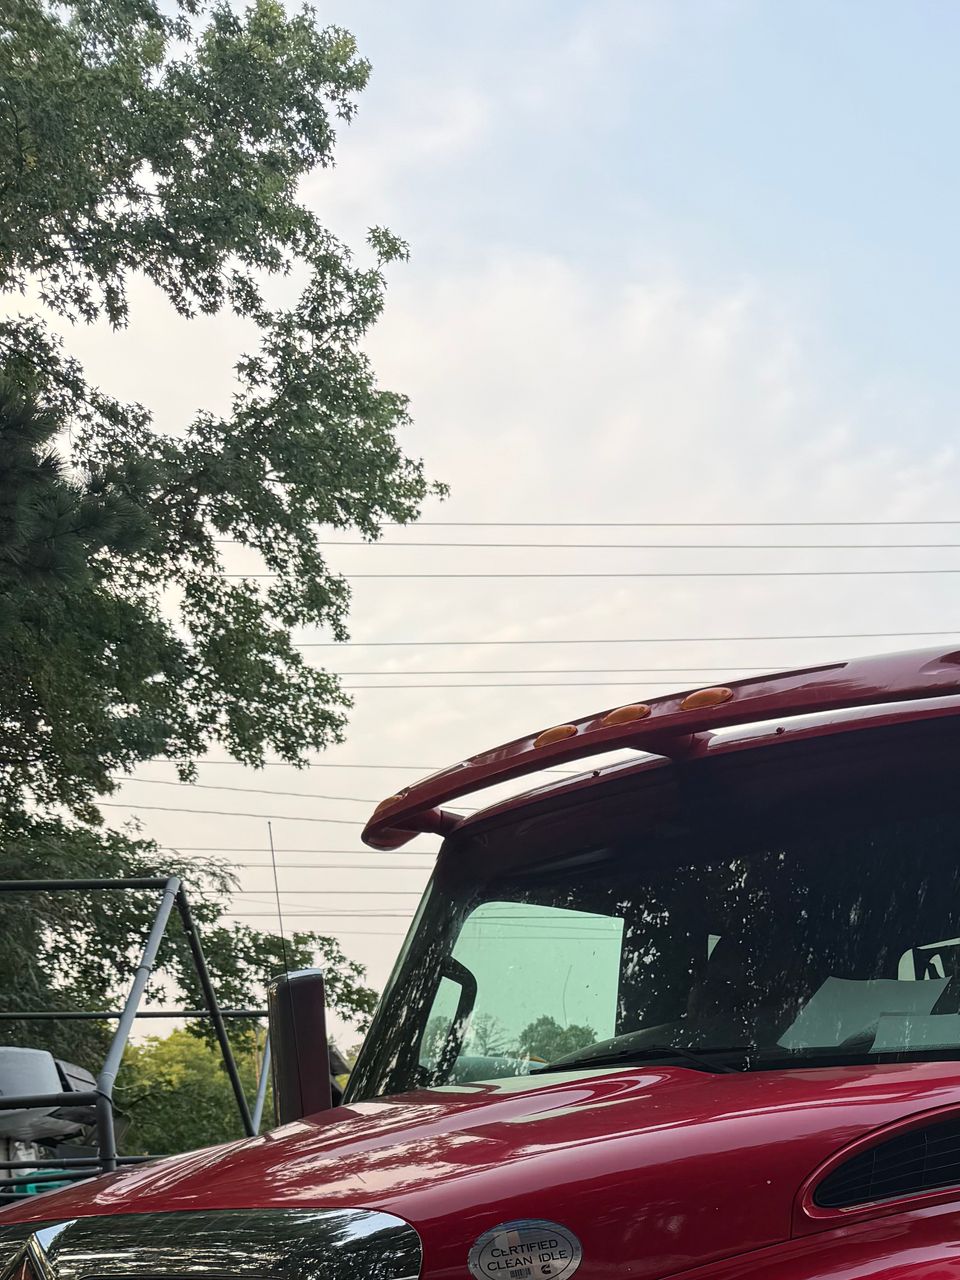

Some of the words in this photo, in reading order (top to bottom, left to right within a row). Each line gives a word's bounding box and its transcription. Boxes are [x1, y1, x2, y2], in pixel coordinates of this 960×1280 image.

[490, 1239, 559, 1259] CERTIFIED
[486, 1255, 533, 1272] CLEAN
[538, 1249, 568, 1264] IDLE
